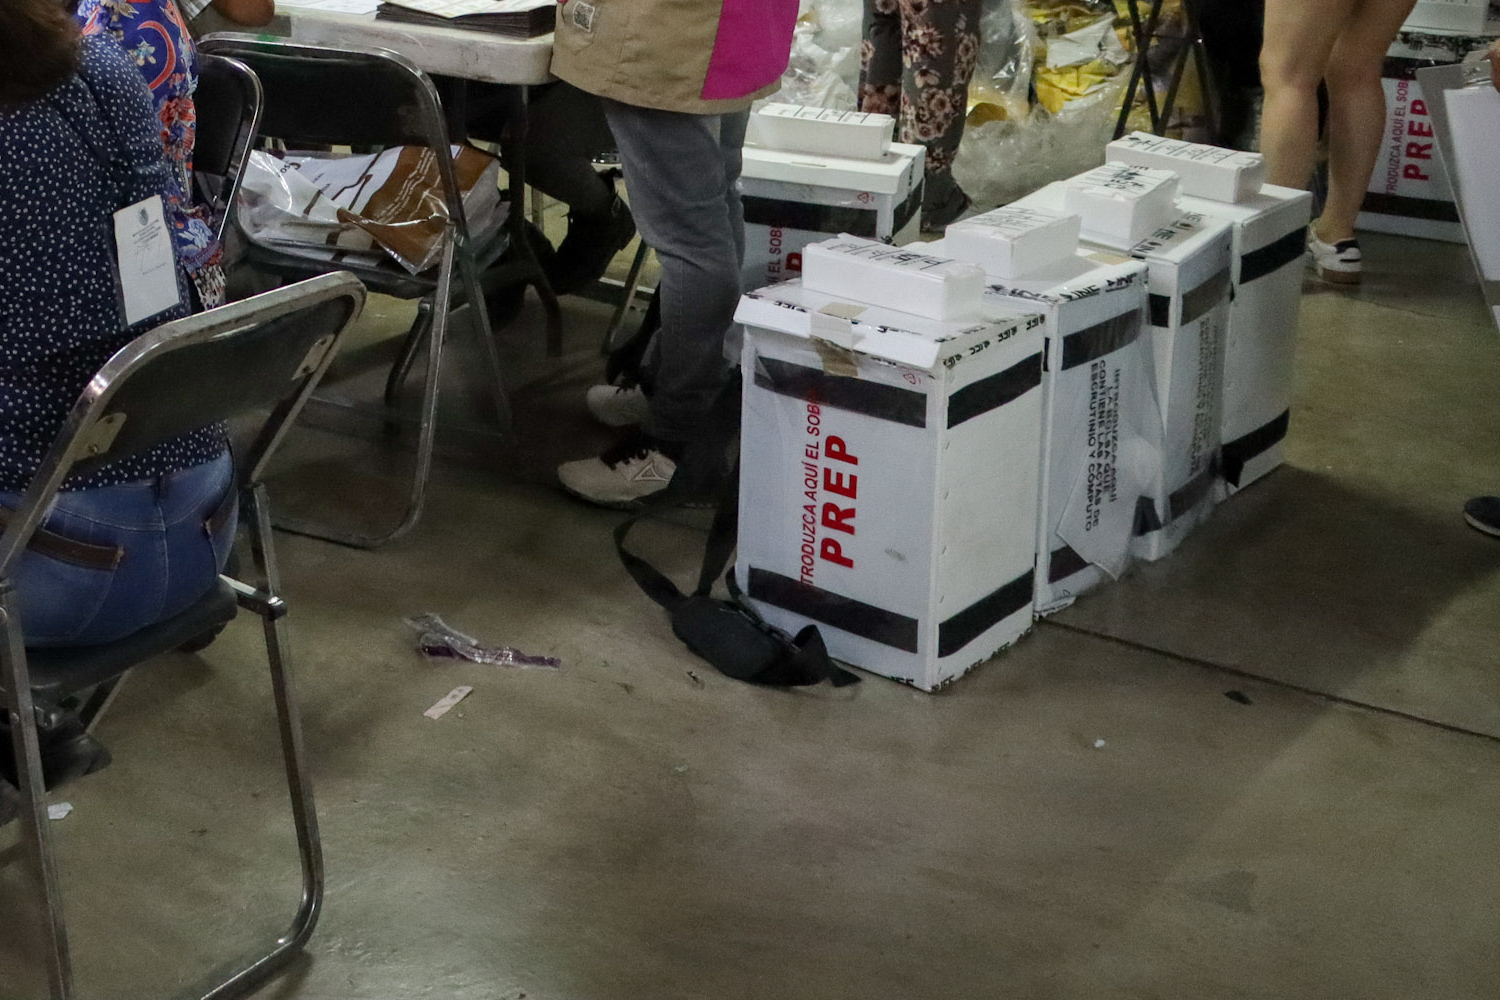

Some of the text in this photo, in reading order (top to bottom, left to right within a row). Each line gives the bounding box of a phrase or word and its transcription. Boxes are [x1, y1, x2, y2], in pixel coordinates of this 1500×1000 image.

[1395, 104, 1406, 118] EL
[1088, 362, 1098, 447] ESCRUTINIO
[1097, 360, 1106, 430] CONTIENE
[1111, 369, 1120, 465] INTRODUZCA
[806, 441, 819, 460] EL
[1088, 450, 1096, 458] Y
[1103, 386, 1114, 494] LA BOLSA QUE
[802, 461, 819, 501] AQUÍ
[820, 435, 858, 569] PREP
[1092, 509, 1100, 527] DE
